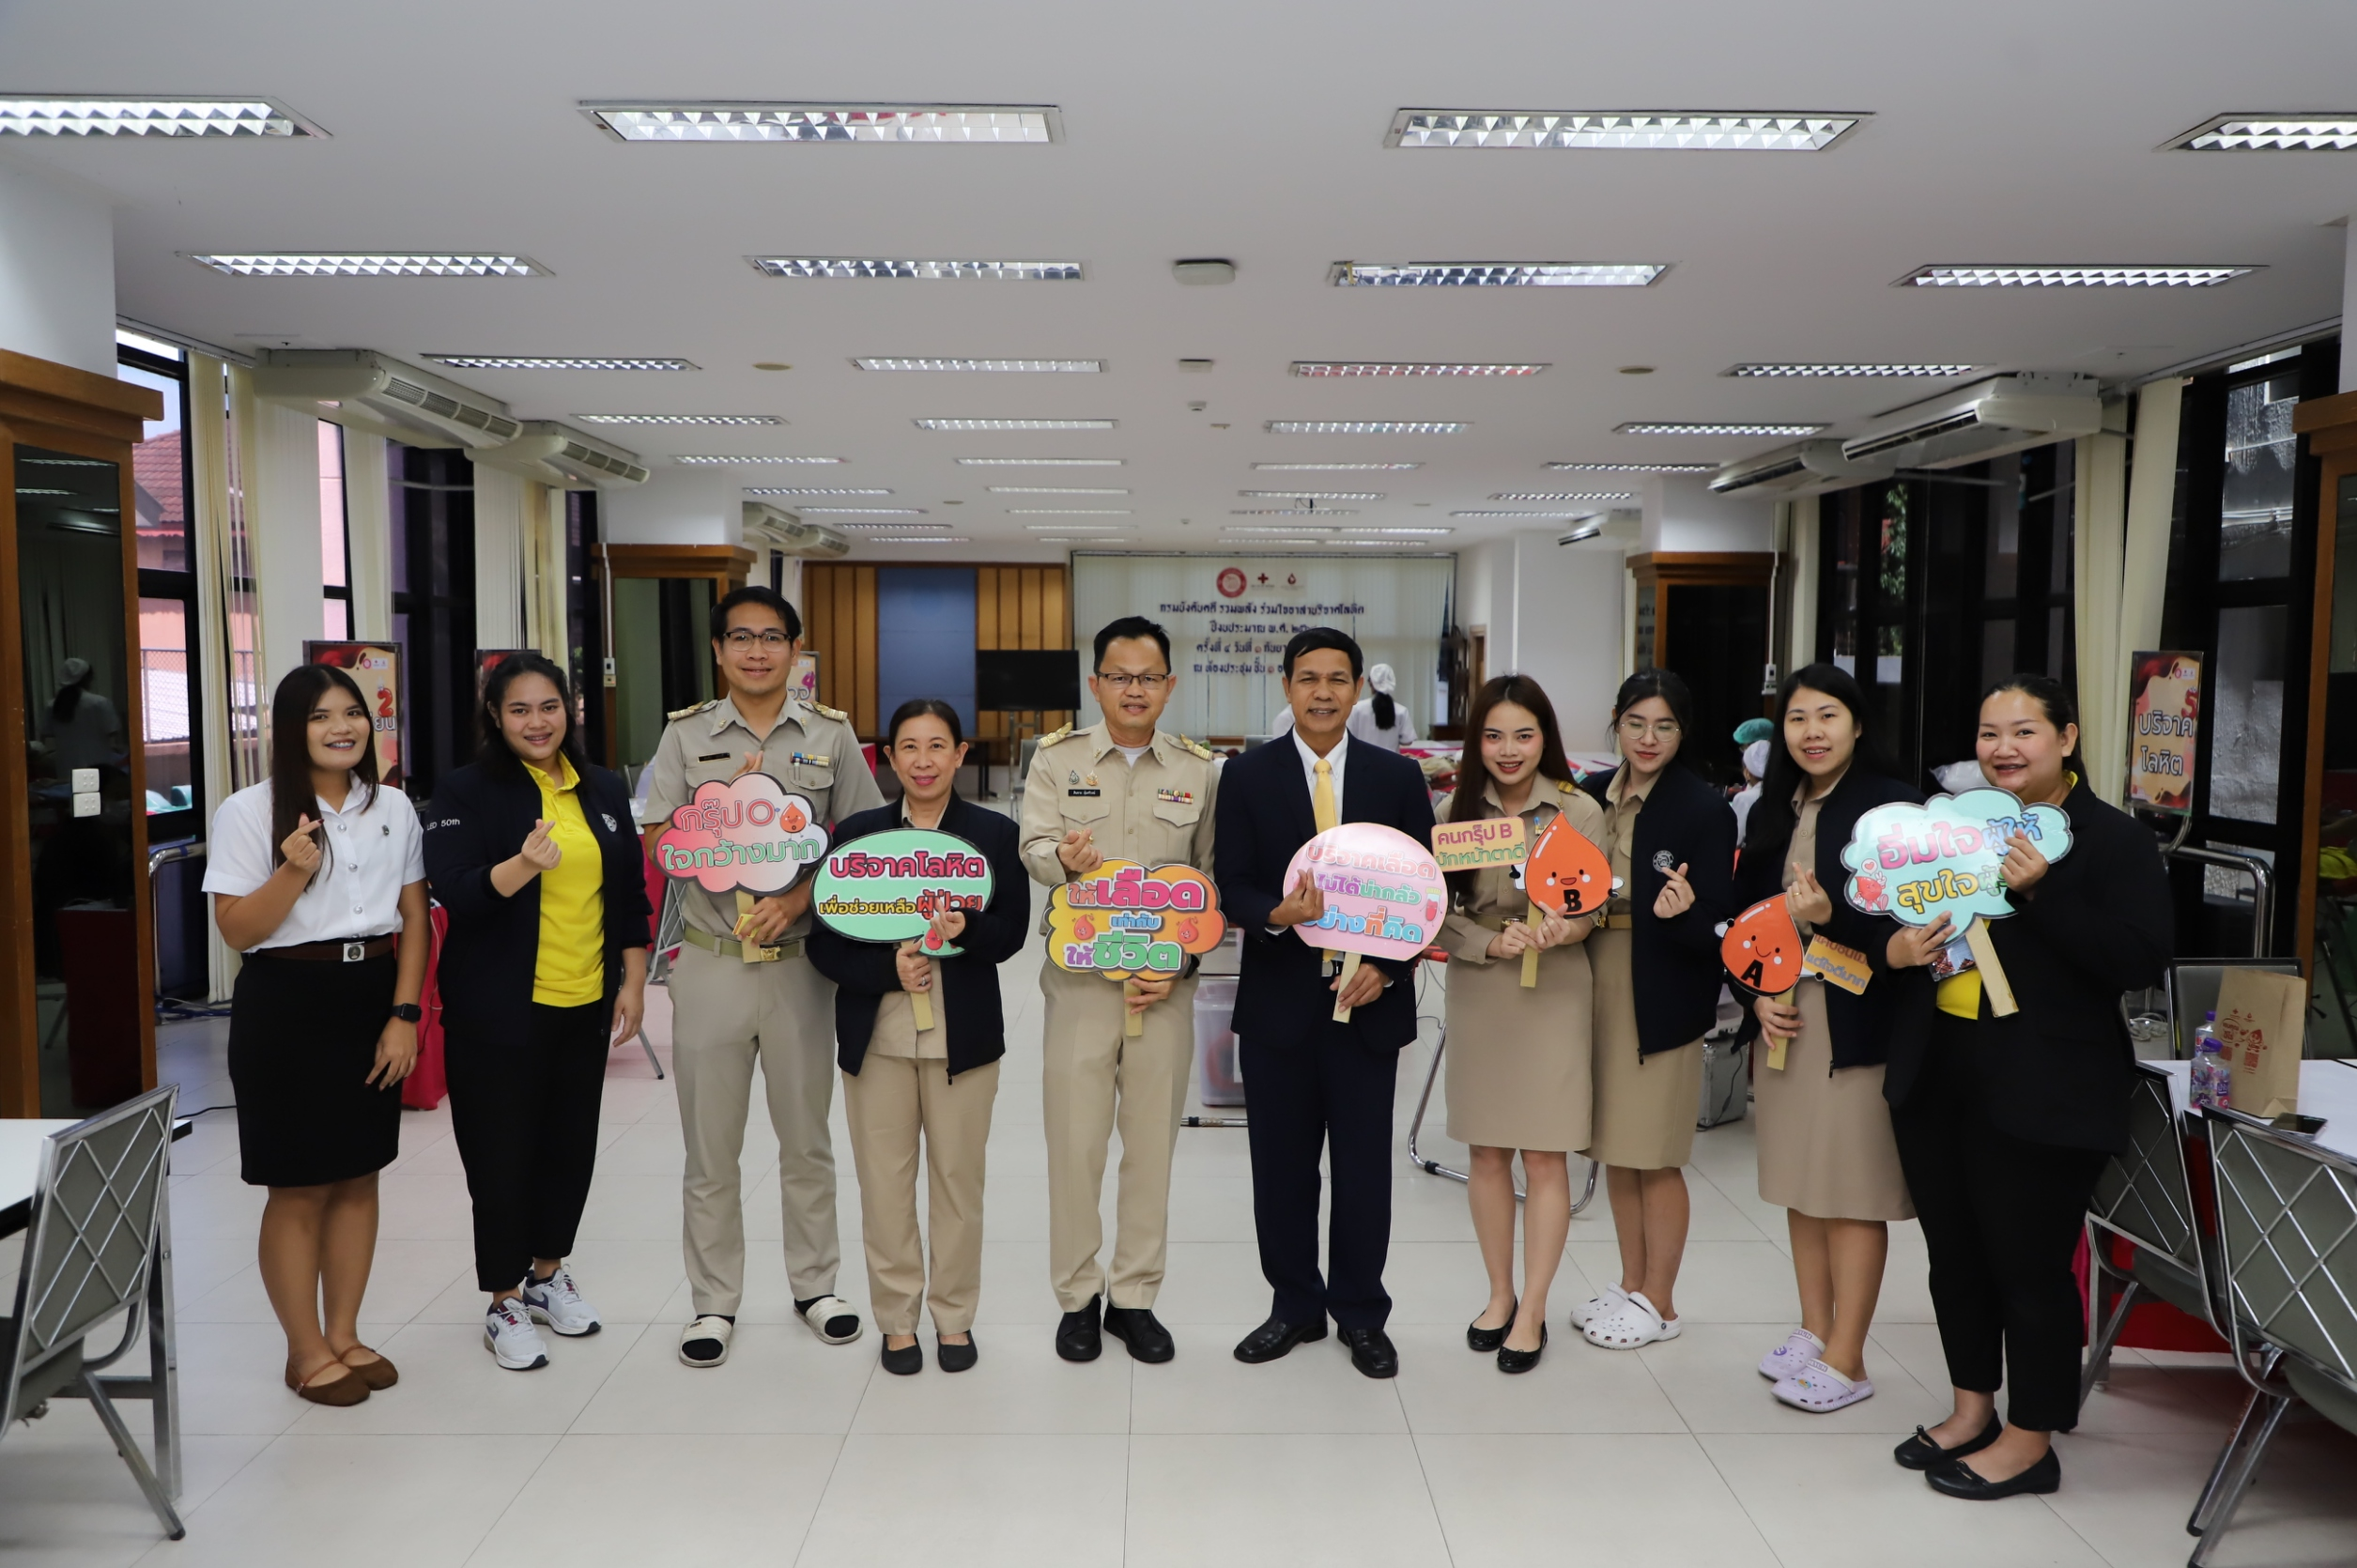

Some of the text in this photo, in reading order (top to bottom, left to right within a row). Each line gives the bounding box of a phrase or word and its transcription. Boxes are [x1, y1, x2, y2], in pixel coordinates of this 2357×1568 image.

[377, 688, 393, 717] 2
[2138, 710, 2194, 737] บริจาค
[2140, 746, 2183, 776] โลหิต
[441, 819, 460, 827] 50th
[681, 798, 776, 838] กรุ๊ป O
[1438, 822, 1513, 847] คนกรุ๊ป B
[661, 839, 820, 870] ใจกว้างมาก
[830, 851, 985, 878] บริจาคโลหิต
[1306, 845, 1436, 879] บริจาคเลือด
[1068, 869, 1204, 908] ให้เลือด
[1564, 889, 1582, 912] B
[1111, 914, 1160, 929] เท่ากับ
[1066, 930, 1181, 969] ให้ชีวิต
[1741, 960, 1764, 989] A
